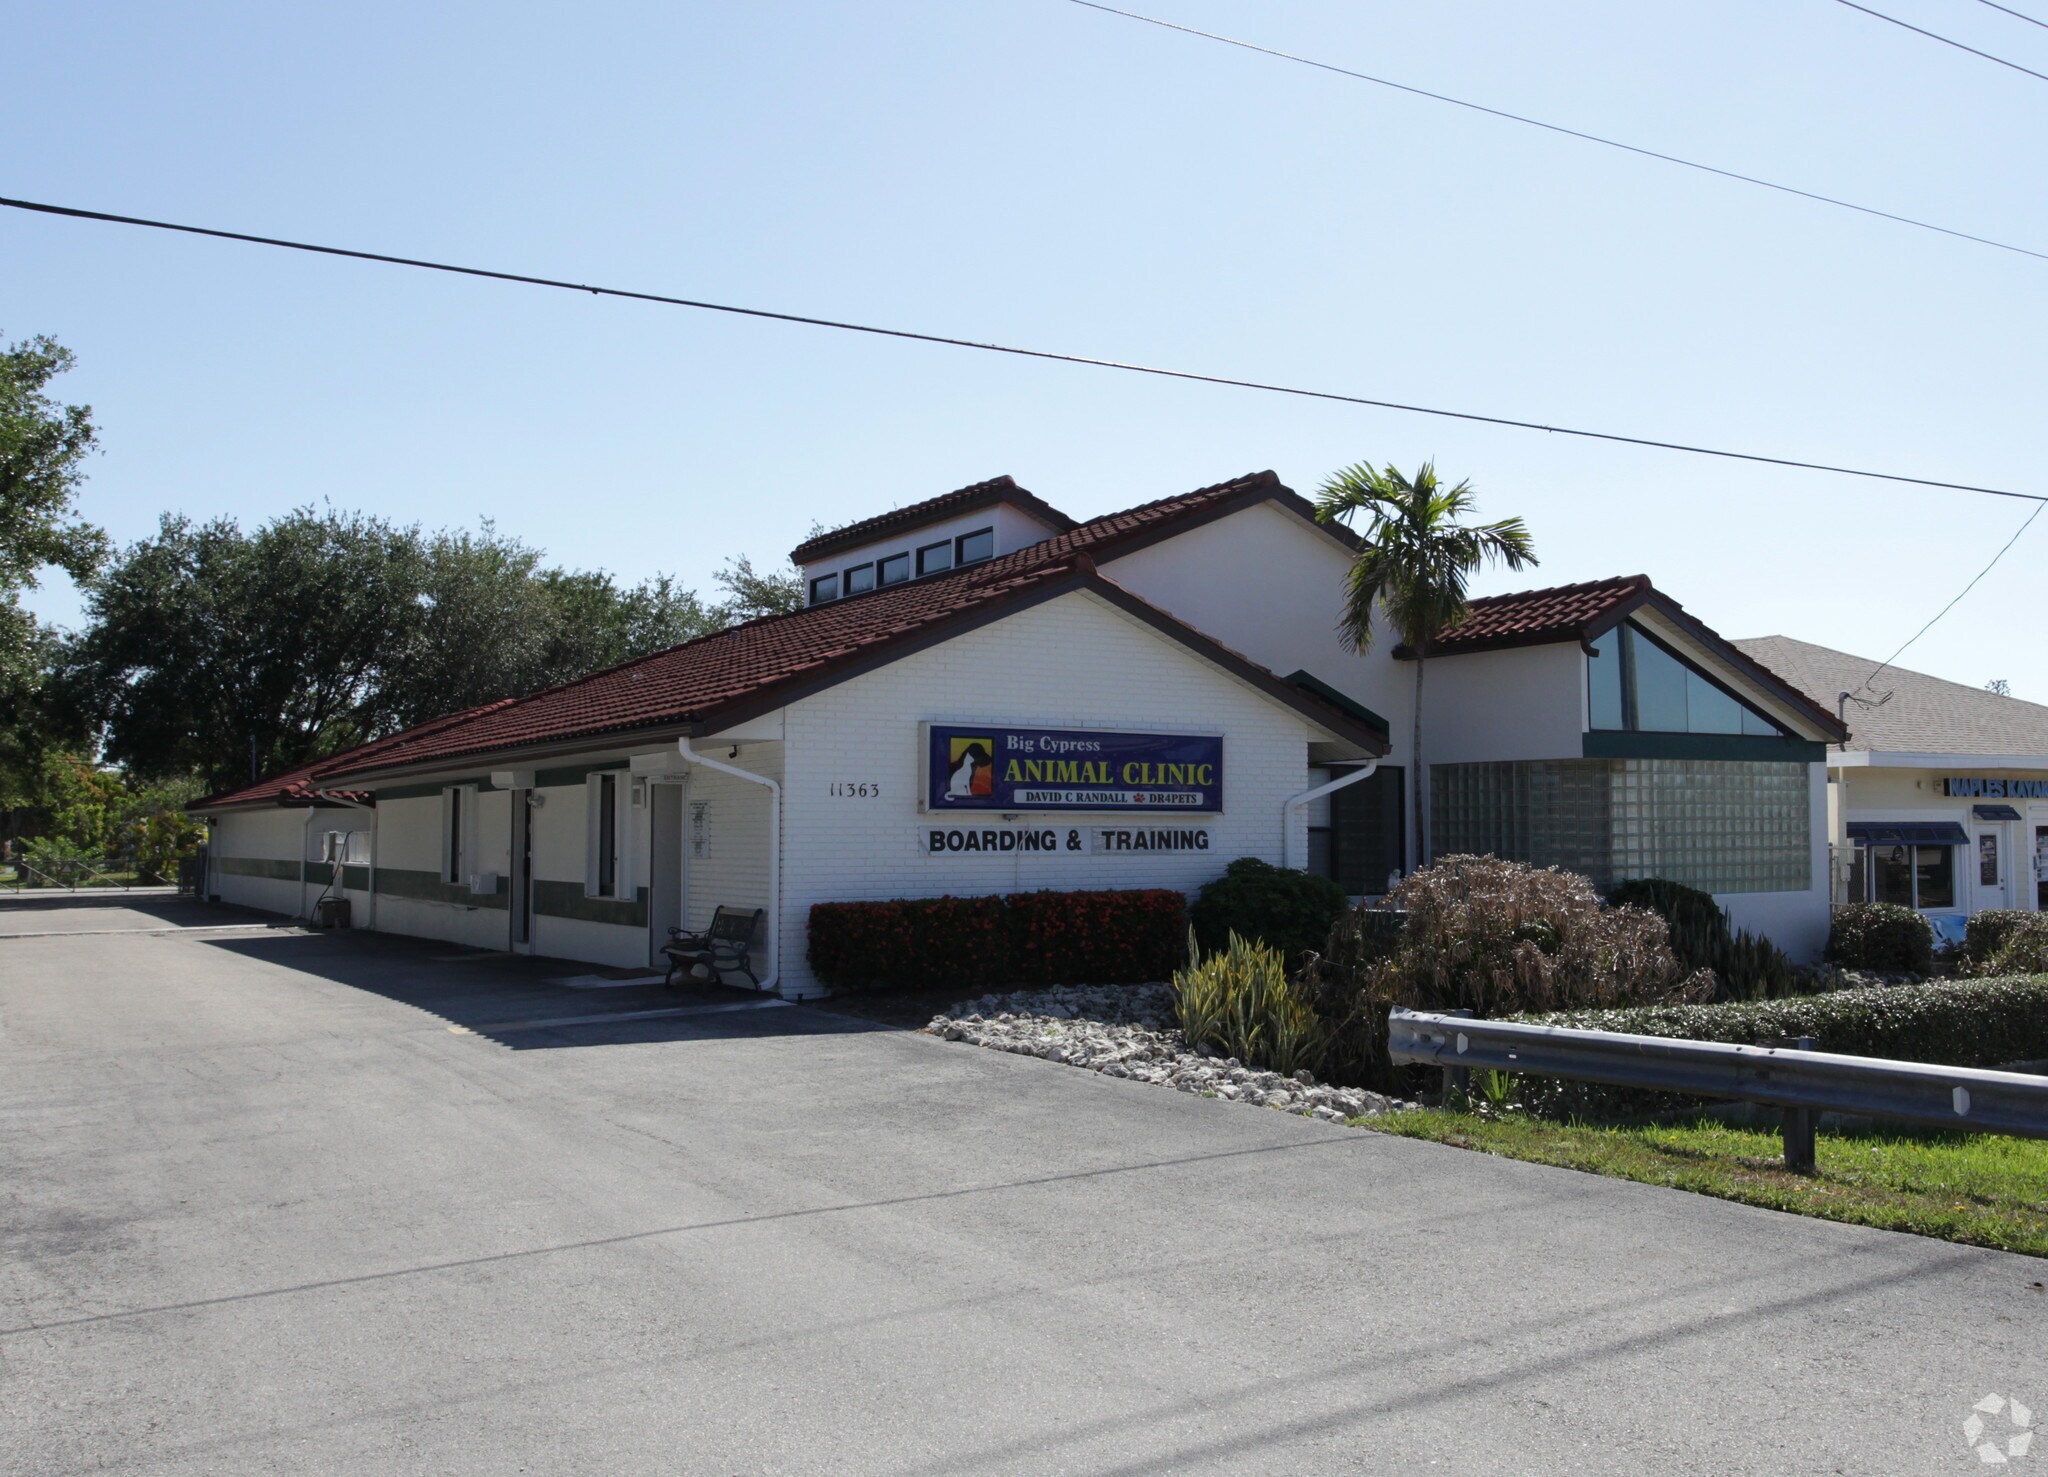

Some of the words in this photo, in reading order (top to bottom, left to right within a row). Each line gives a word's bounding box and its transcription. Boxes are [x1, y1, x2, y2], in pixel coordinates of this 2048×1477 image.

[1007, 735, 1034, 753] Big
[1040, 735, 1100, 753] Cypress
[1004, 758, 1113, 784] ANIMAL
[1122, 762, 1213, 786] CLINIC
[830, 783, 879, 797] 11363
[1025, 791, 1062, 802] DAVID
[1065, 792, 1073, 802] C
[1076, 792, 1128, 803] RANDALL
[1149, 793, 1197, 804] DR4PETS
[1949, 778, 2005, 798] NAPLES
[929, 830, 1057, 851] BOARDING
[1066, 829, 1082, 851] &
[1101, 830, 1209, 850] TRAINING
